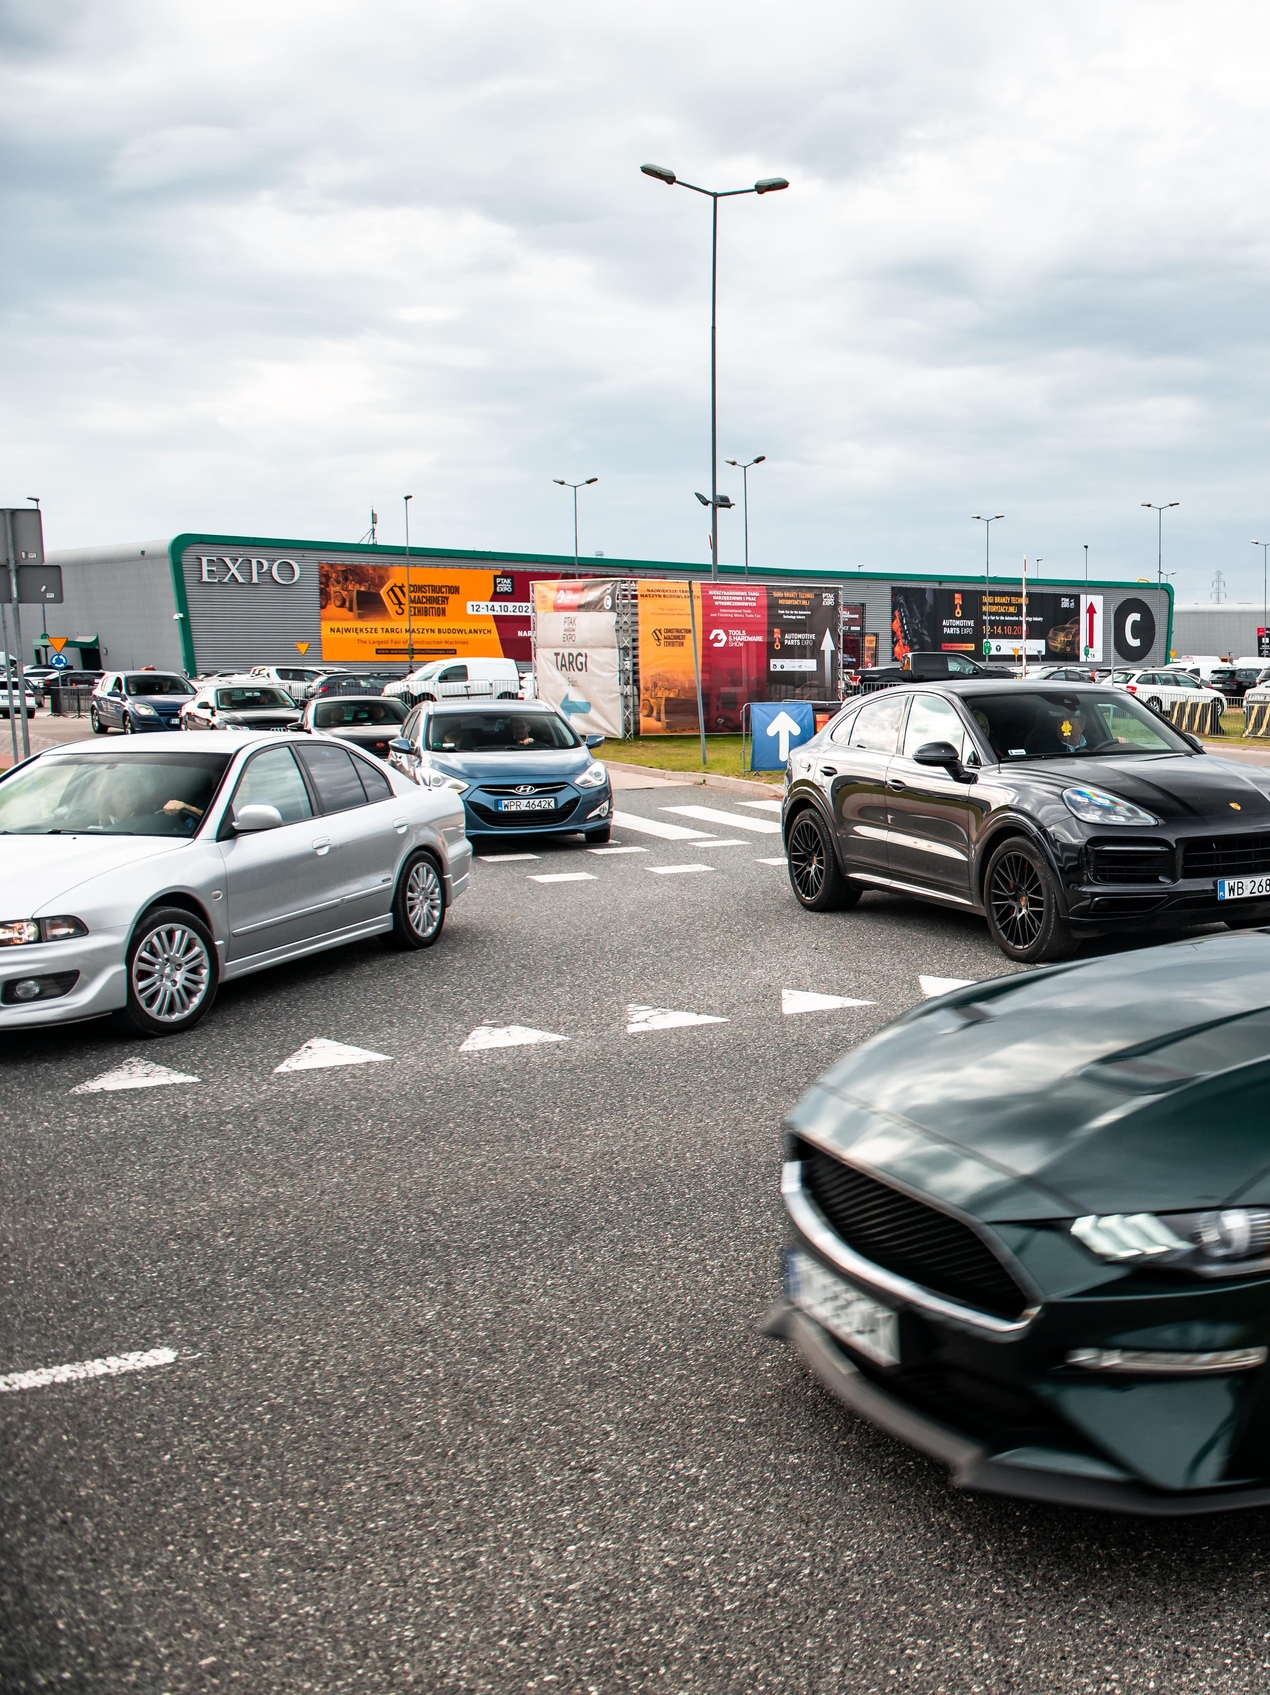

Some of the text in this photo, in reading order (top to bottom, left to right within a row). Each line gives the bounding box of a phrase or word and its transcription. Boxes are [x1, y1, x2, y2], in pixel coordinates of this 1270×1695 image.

[197, 556, 301, 586] EXPO
[409, 584, 460, 595] CONSTRUCTION
[409, 596, 449, 605] MACHINERY
[409, 606, 447, 617] EXHIBITION
[470, 604, 530, 614] 12-14.10.202
[563, 616, 577, 627] PTAK
[942, 619, 975, 627] AUTOMOTIVE
[329, 627, 379, 635] NAJWIĘKSZE
[943, 627, 973, 635] PARTS EXPO
[1125, 612, 1141, 647] C
[562, 633, 576, 643] EXPO
[553, 652, 588, 673] TARGI
[502, 801, 523, 811] WPR
[524, 799, 554, 810] 4642K
[1228, 880, 1245, 897] WB
